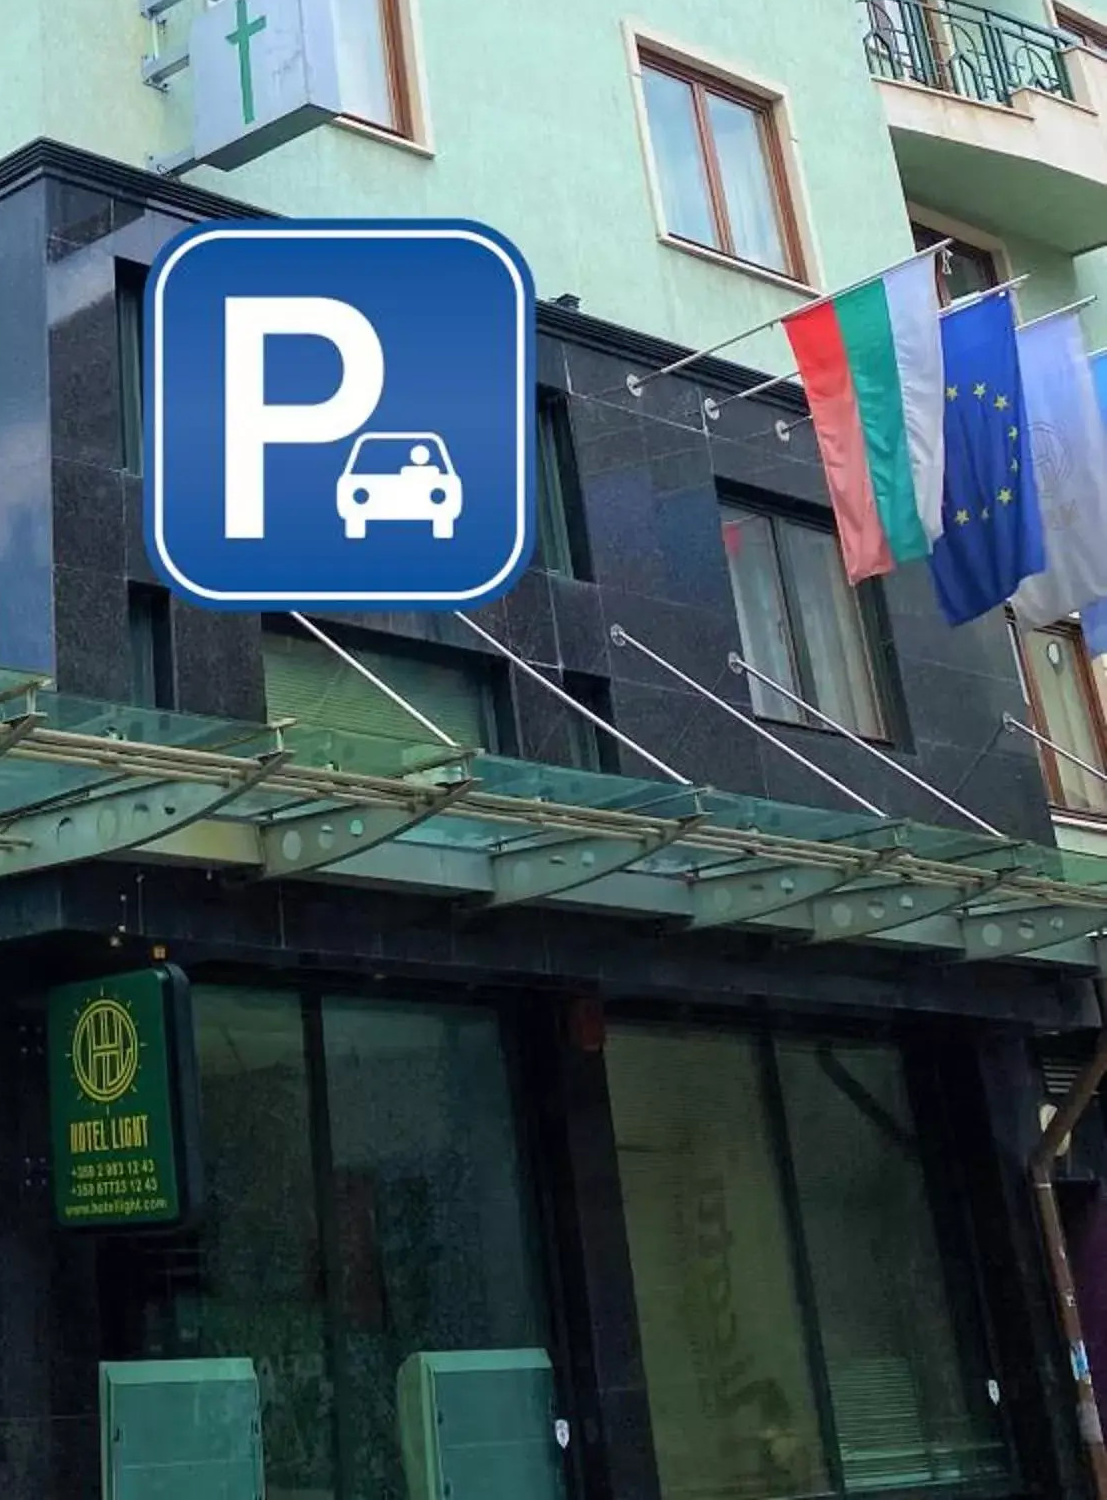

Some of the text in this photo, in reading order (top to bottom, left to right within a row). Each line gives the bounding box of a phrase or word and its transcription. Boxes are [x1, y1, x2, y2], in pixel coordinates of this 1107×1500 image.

[70, 1114, 149, 1154] HOTEL LIGHT
[142, 1157, 155, 1174] 43
[144, 1176, 158, 1193] 43
